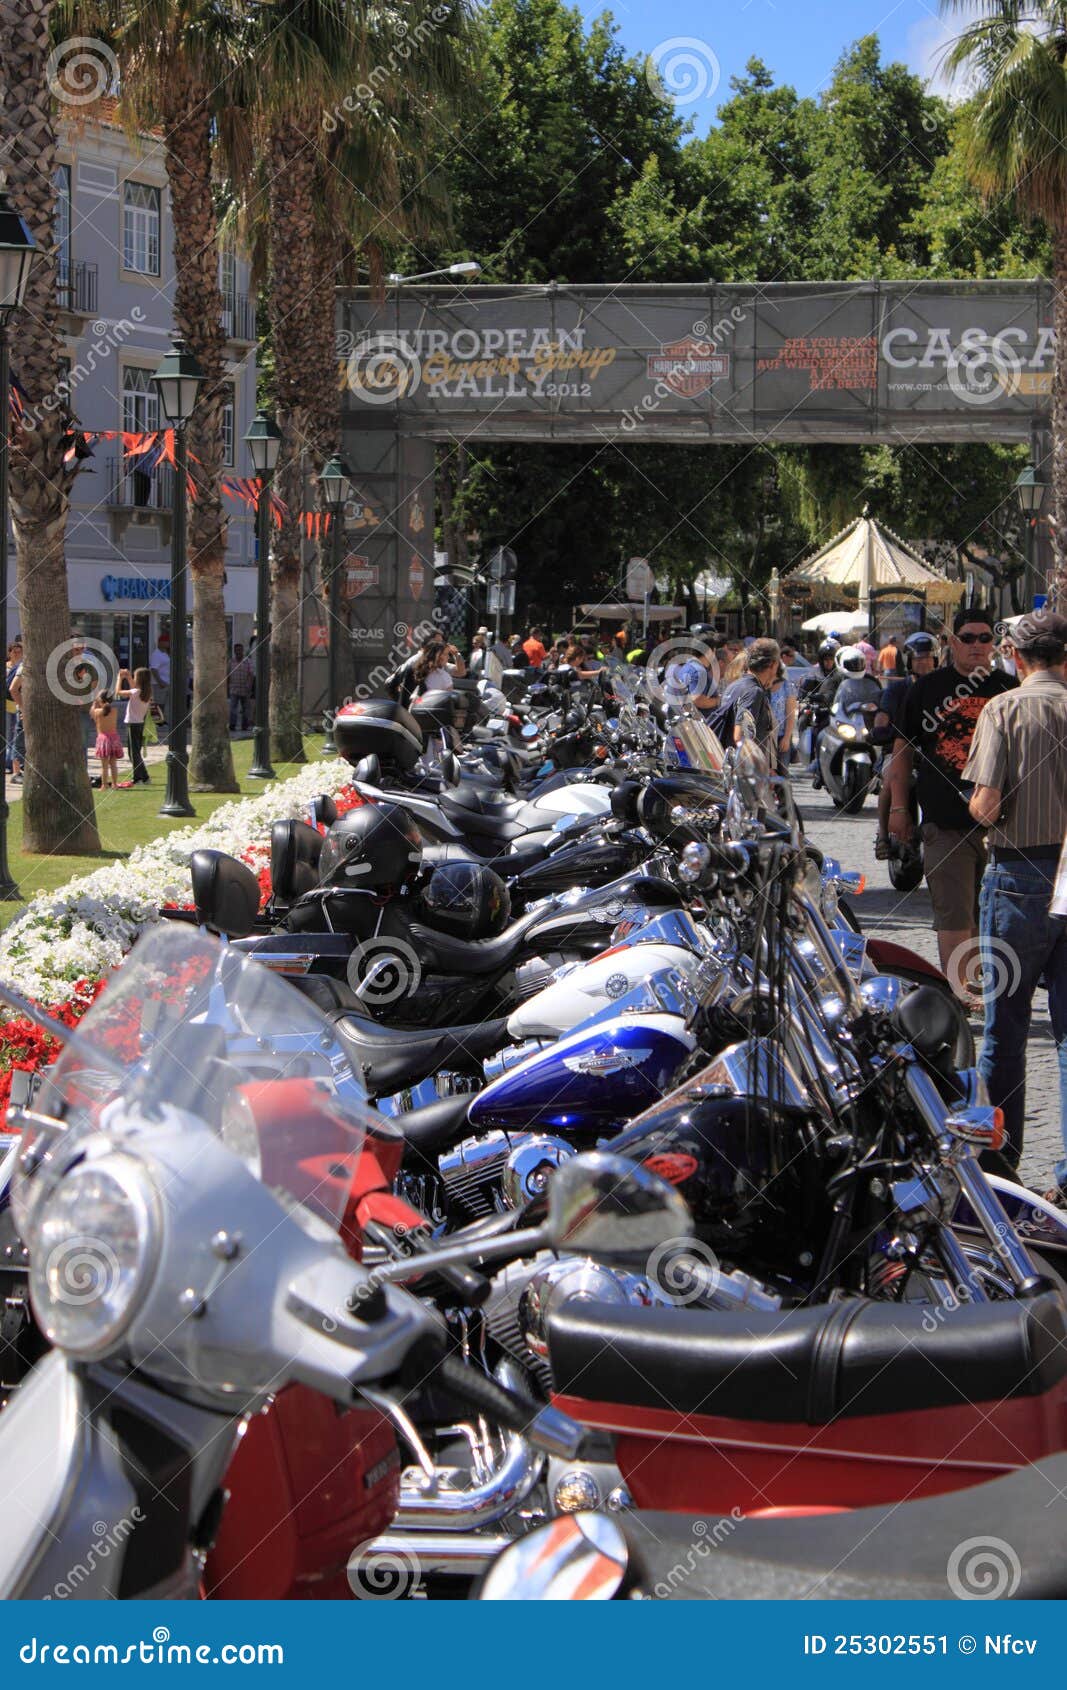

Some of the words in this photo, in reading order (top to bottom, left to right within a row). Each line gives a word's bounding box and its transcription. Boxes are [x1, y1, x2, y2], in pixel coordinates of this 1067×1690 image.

[375, 328, 586, 359] EUROPEAN
[778, 348, 820, 358] HASTA
[824, 348, 877, 358] PRONTO
[785, 338, 807, 348] SEE
[811, 337, 837, 348] YOU
[840, 337, 877, 348] SOON
[422, 352, 520, 385] Owners
[526, 341, 616, 381] Group
[756, 359, 781, 369] AUF
[428, 367, 551, 398] RALLY
[546, 383, 592, 397] 2012
